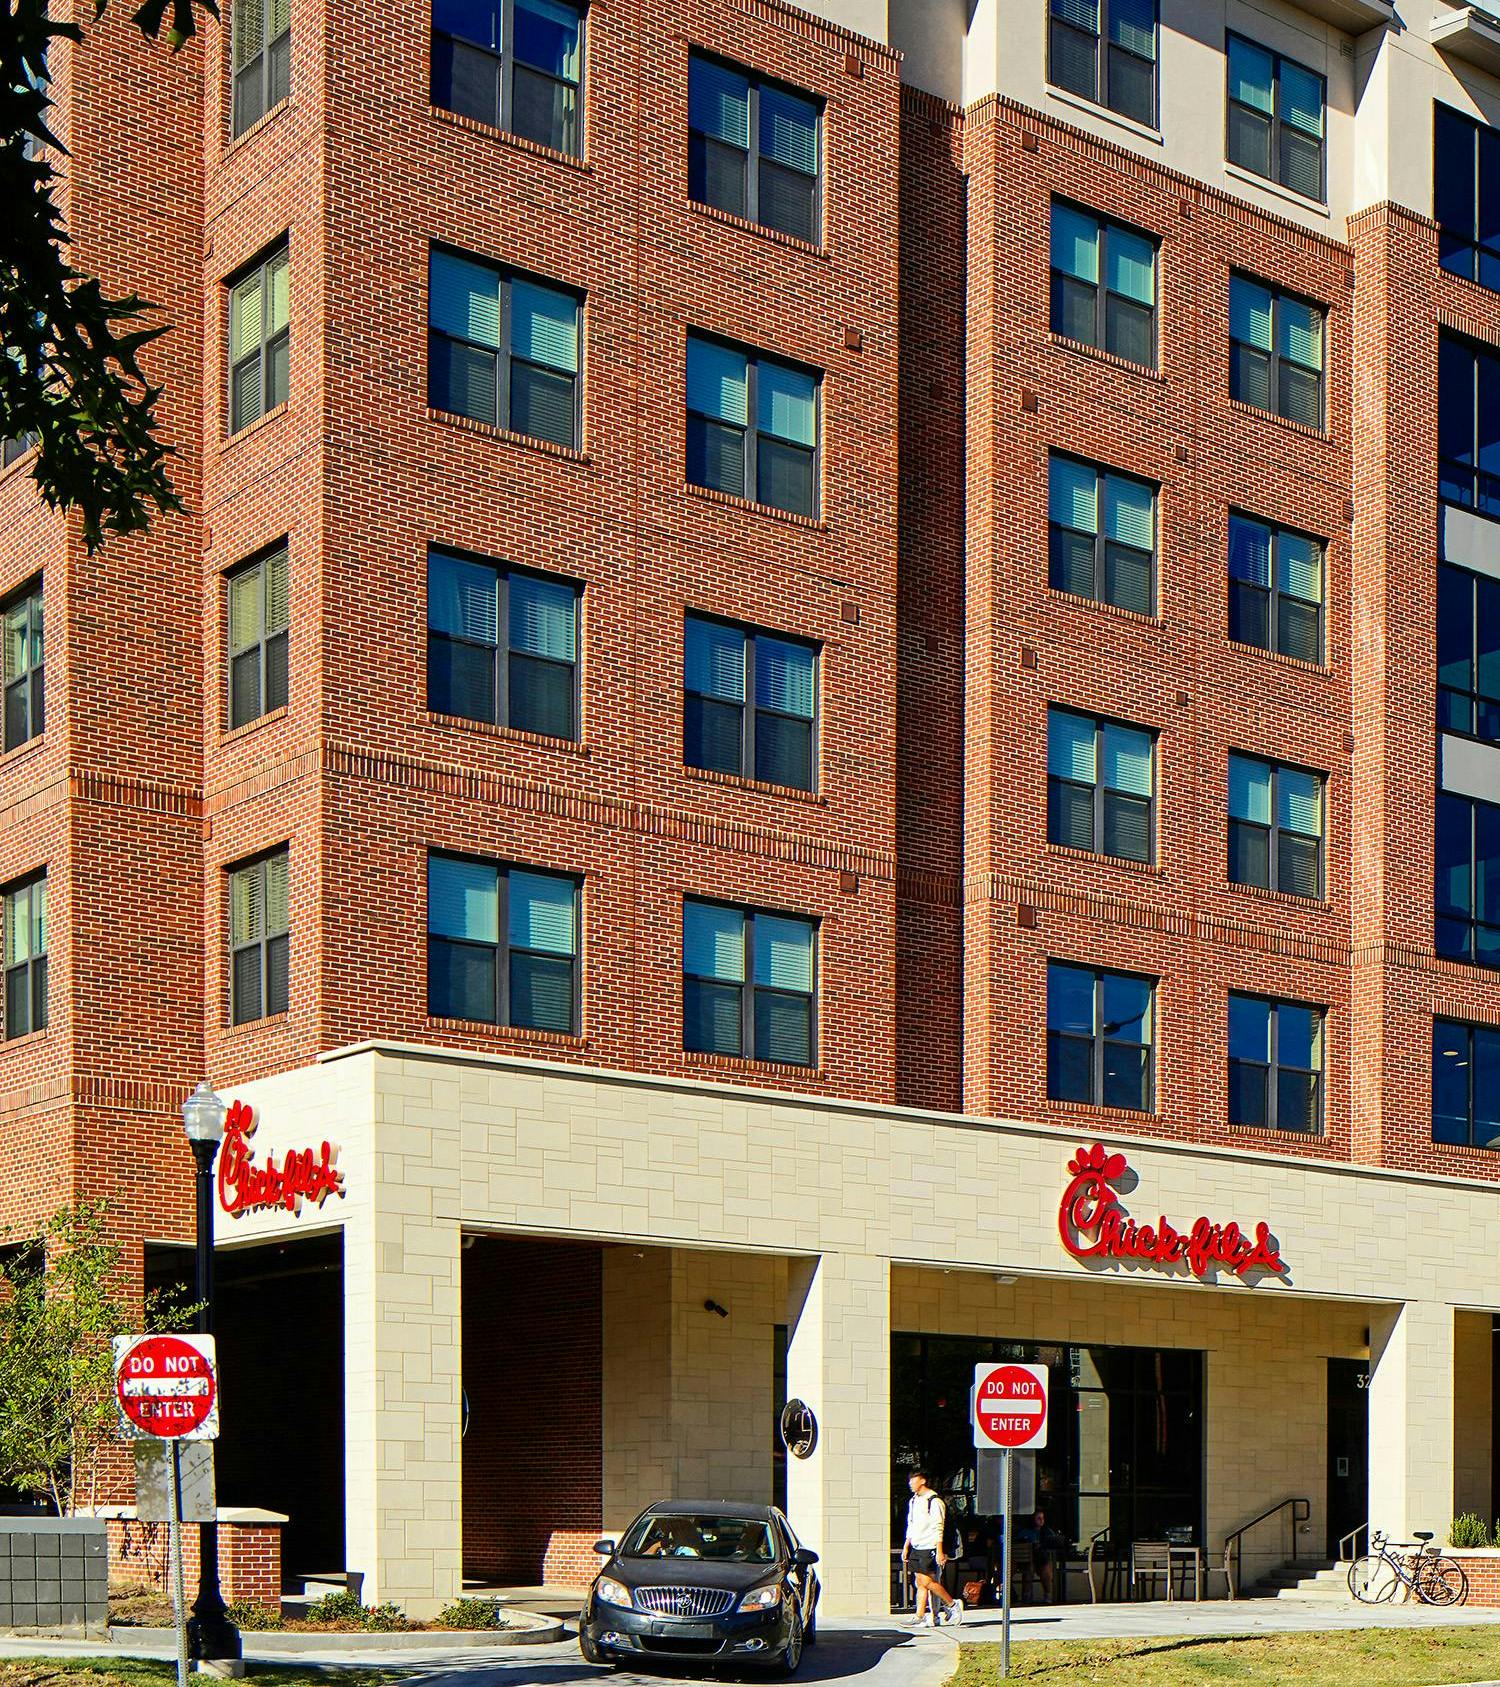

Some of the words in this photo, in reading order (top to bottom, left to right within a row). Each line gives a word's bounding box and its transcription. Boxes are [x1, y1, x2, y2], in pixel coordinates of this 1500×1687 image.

[1059, 1143, 1284, 1277] Chick-fil-A
[131, 1356, 154, 1373] DO
[165, 1355, 199, 1373] NOT
[987, 1381, 1004, 1395] DO
[1012, 1382, 1036, 1395] NOT
[140, 1401, 195, 1418] ENTER
[991, 1418, 1031, 1431] ENTER
